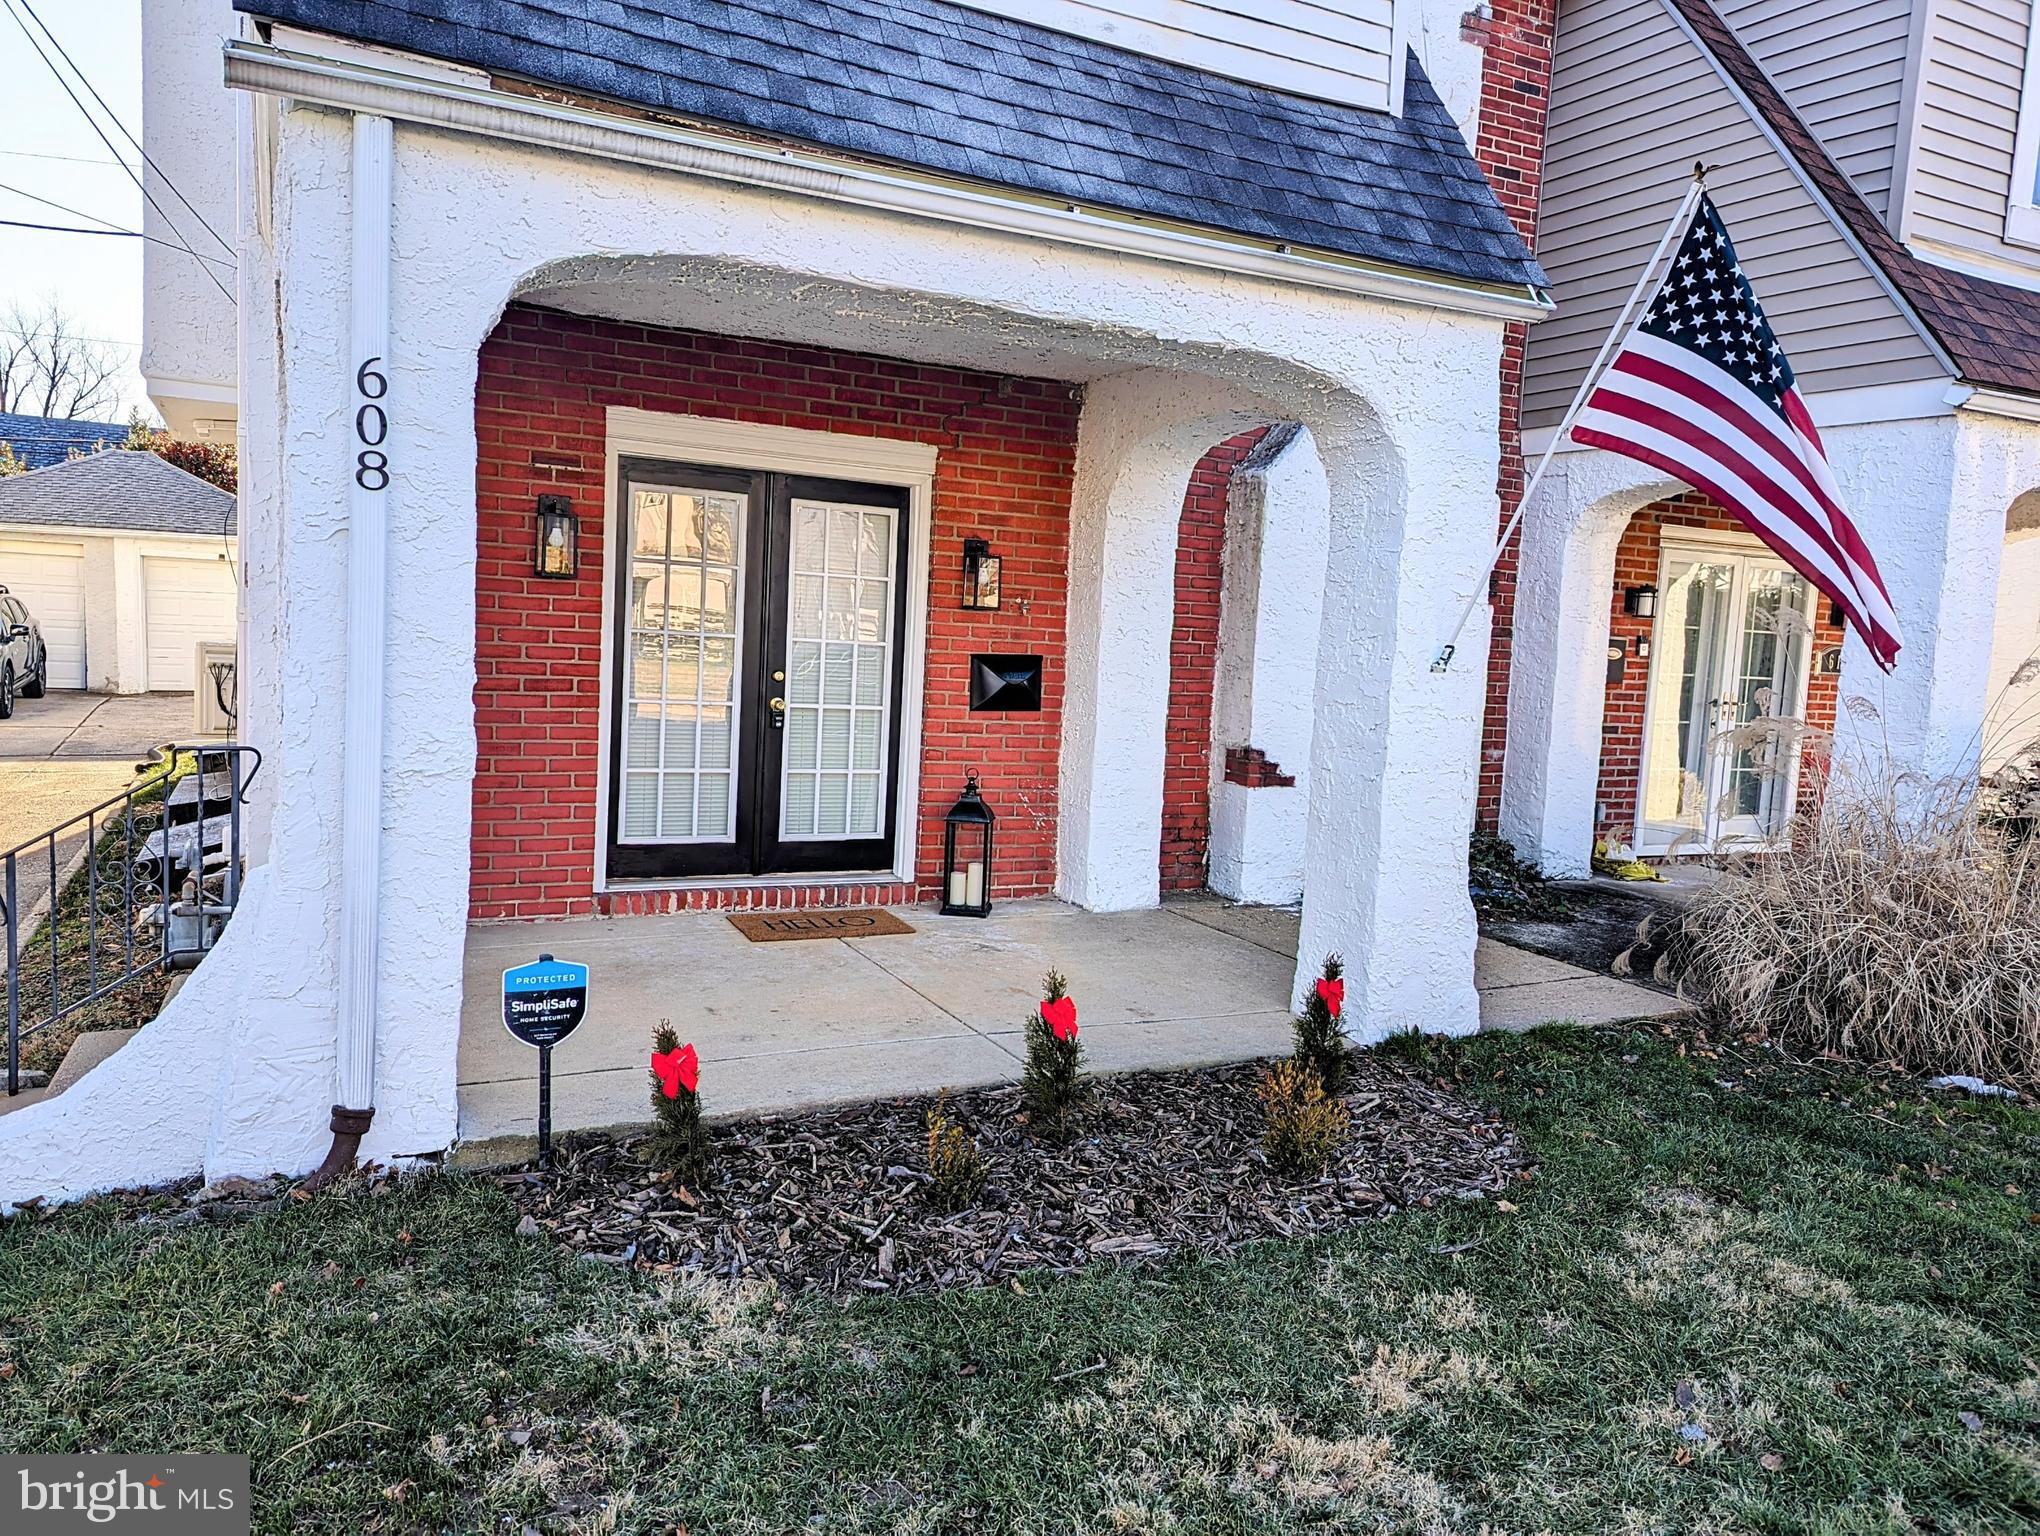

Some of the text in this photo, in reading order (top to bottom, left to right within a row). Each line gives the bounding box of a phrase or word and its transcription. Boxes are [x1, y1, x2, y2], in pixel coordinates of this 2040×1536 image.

[355, 356, 390, 491] 608
[763, 917, 875, 931] HELLO
[516, 974, 576, 985] PROTECTED
[511, 998, 577, 1013] SimpliSafe
[540, 1014, 570, 1022] SECURITY
